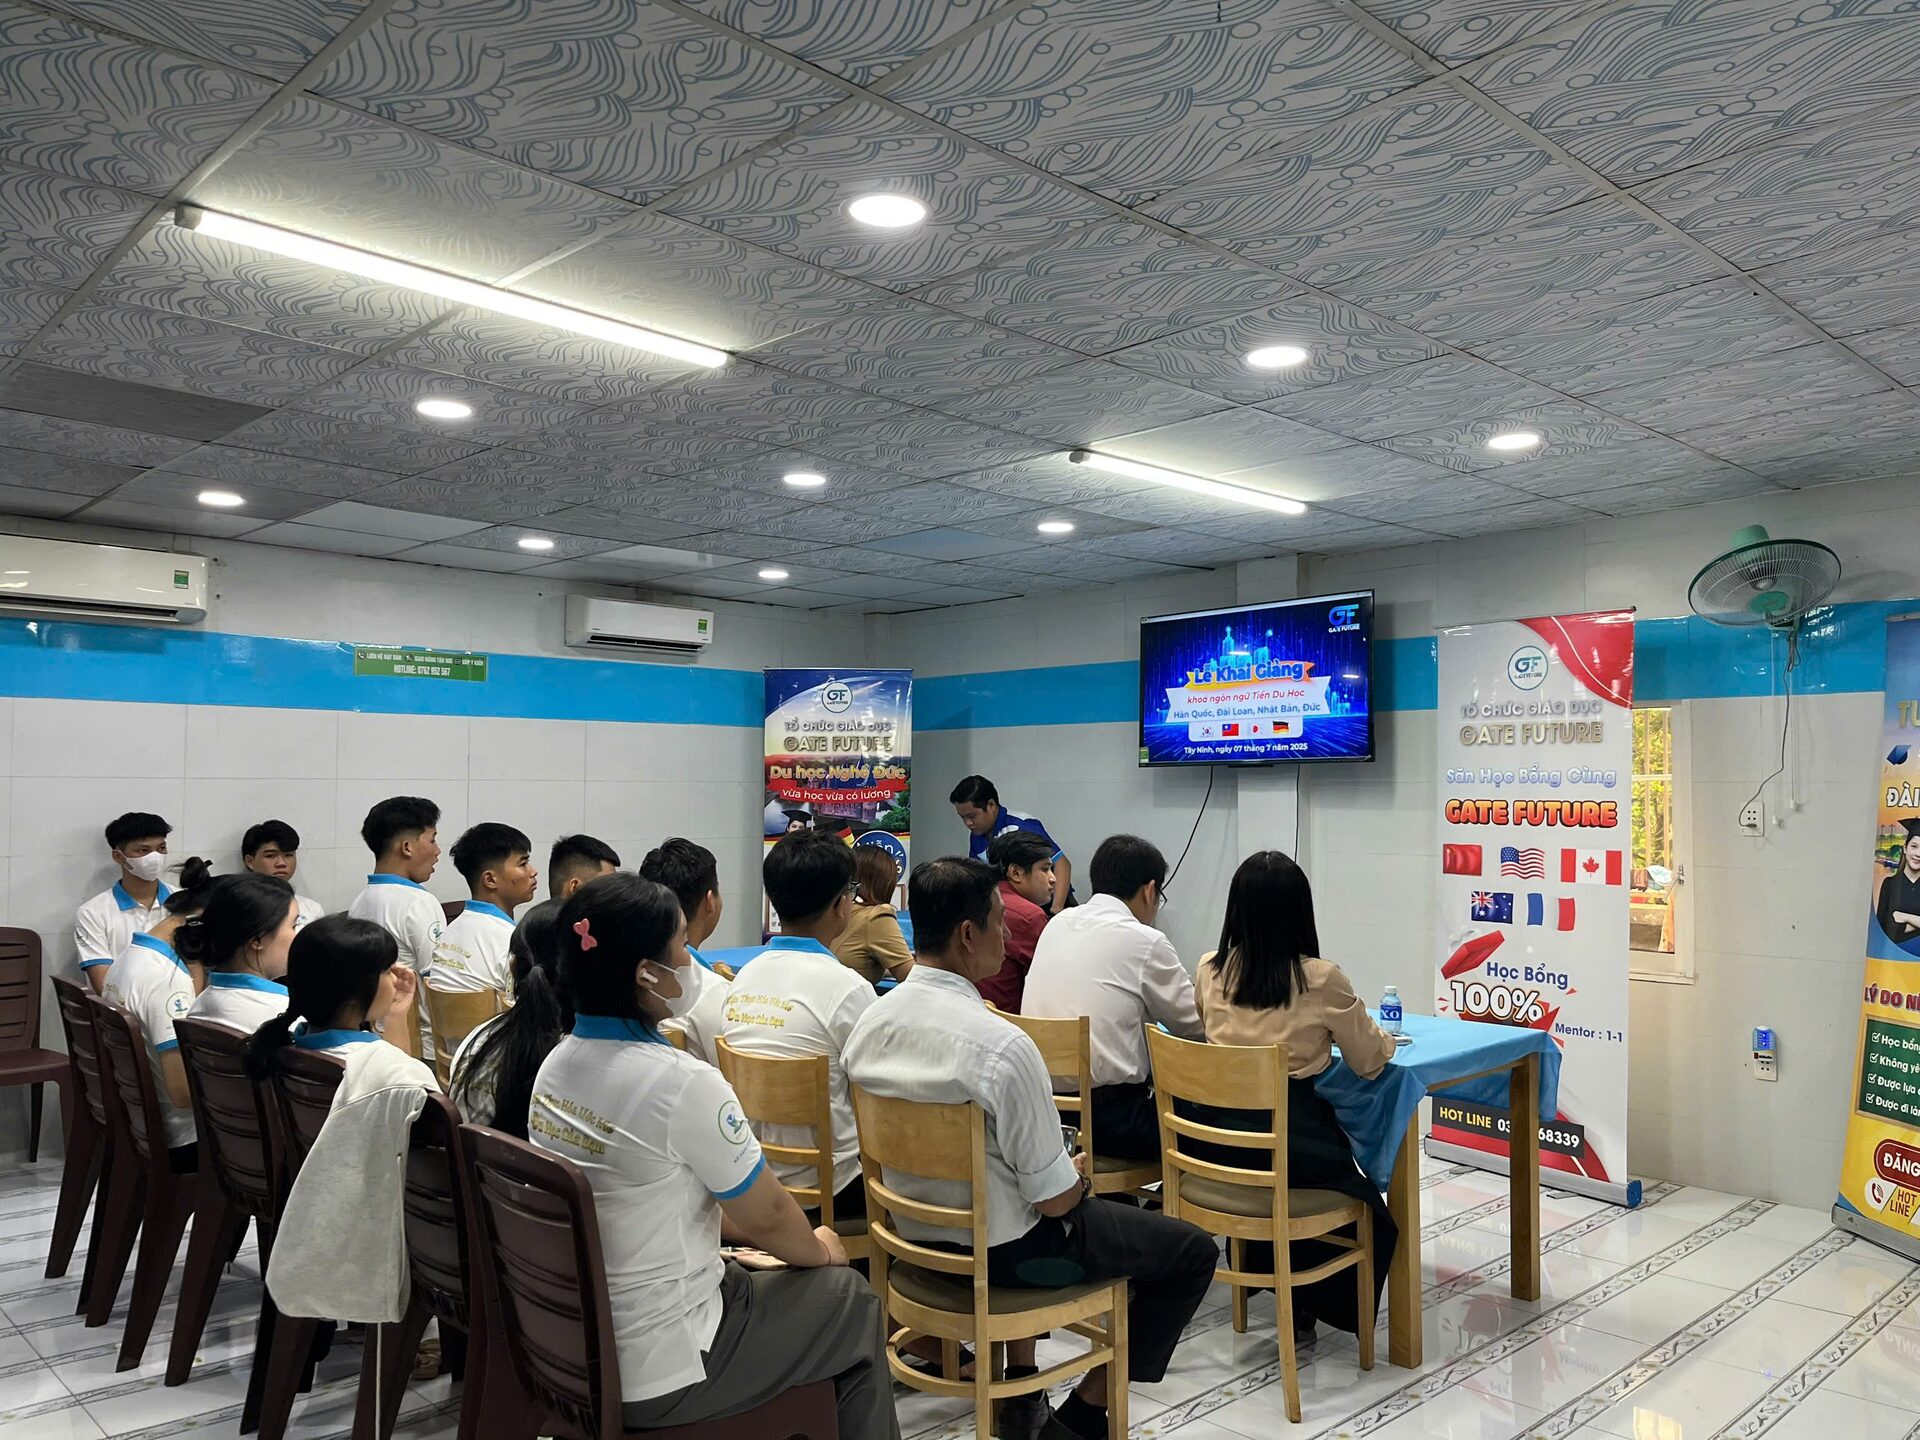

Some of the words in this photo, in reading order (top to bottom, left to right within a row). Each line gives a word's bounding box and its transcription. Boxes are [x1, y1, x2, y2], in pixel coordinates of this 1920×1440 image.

[1194, 663, 1212, 684] Lễ
[1216, 662, 1252, 682] Khai
[1254, 658, 1304, 682] Giảng
[827, 689, 848, 701] GF
[1272, 690, 1285, 699] Du
[1232, 707, 1256, 716] Loan,
[1459, 724, 1515, 746] GATE
[1521, 720, 1604, 745] FUTURE
[783, 736, 828, 752] GATE
[831, 736, 893, 752] FUTURE
[1290, 742, 1308, 751] 2025
[770, 765, 793, 779] Du
[795, 765, 826, 779] học
[872, 765, 906, 779] Đức
[1446, 768, 1475, 784] Săn
[1479, 768, 1514, 788] Học
[1518, 762, 1562, 788] Bổng
[1567, 766, 1617, 788] Cùng
[782, 788, 801, 798] vừa
[804, 790, 824, 801] học
[826, 791, 844, 801] vừa
[846, 791, 858, 800] có
[860, 788, 891, 799] lương
[1886, 781, 1920, 807] ĐÀI
[1445, 799, 1509, 825] GATE
[1513, 799, 1618, 827] FUTURE
[1486, 961, 1519, 982] Học
[1524, 963, 1568, 990] Bổng
[1450, 980, 1544, 1022] 100%
[1880, 989, 1903, 1007] DO
[1555, 1023, 1595, 1039] Mentor
[1606, 1031, 1622, 1042] 1-1
[1882, 1034, 1900, 1048] Học
[1902, 1038, 1920, 1054] bổn
[1880, 1056, 1908, 1073] Không
[1878, 1076, 1901, 1091] Được
[1903, 1082, 1916, 1095] lựa
[1876, 1096, 1899, 1111] Được
[1900, 1103, 1909, 1113] đi
[1439, 1107, 1463, 1122] HOT
[1466, 1114, 1492, 1129] LINE
[1497, 1118, 1580, 1148] 0368339
[1883, 1152, 1920, 1177] ĐĂNG
[1897, 1189, 1918, 1206] HOT
[1889, 1199, 1911, 1218] LINE
